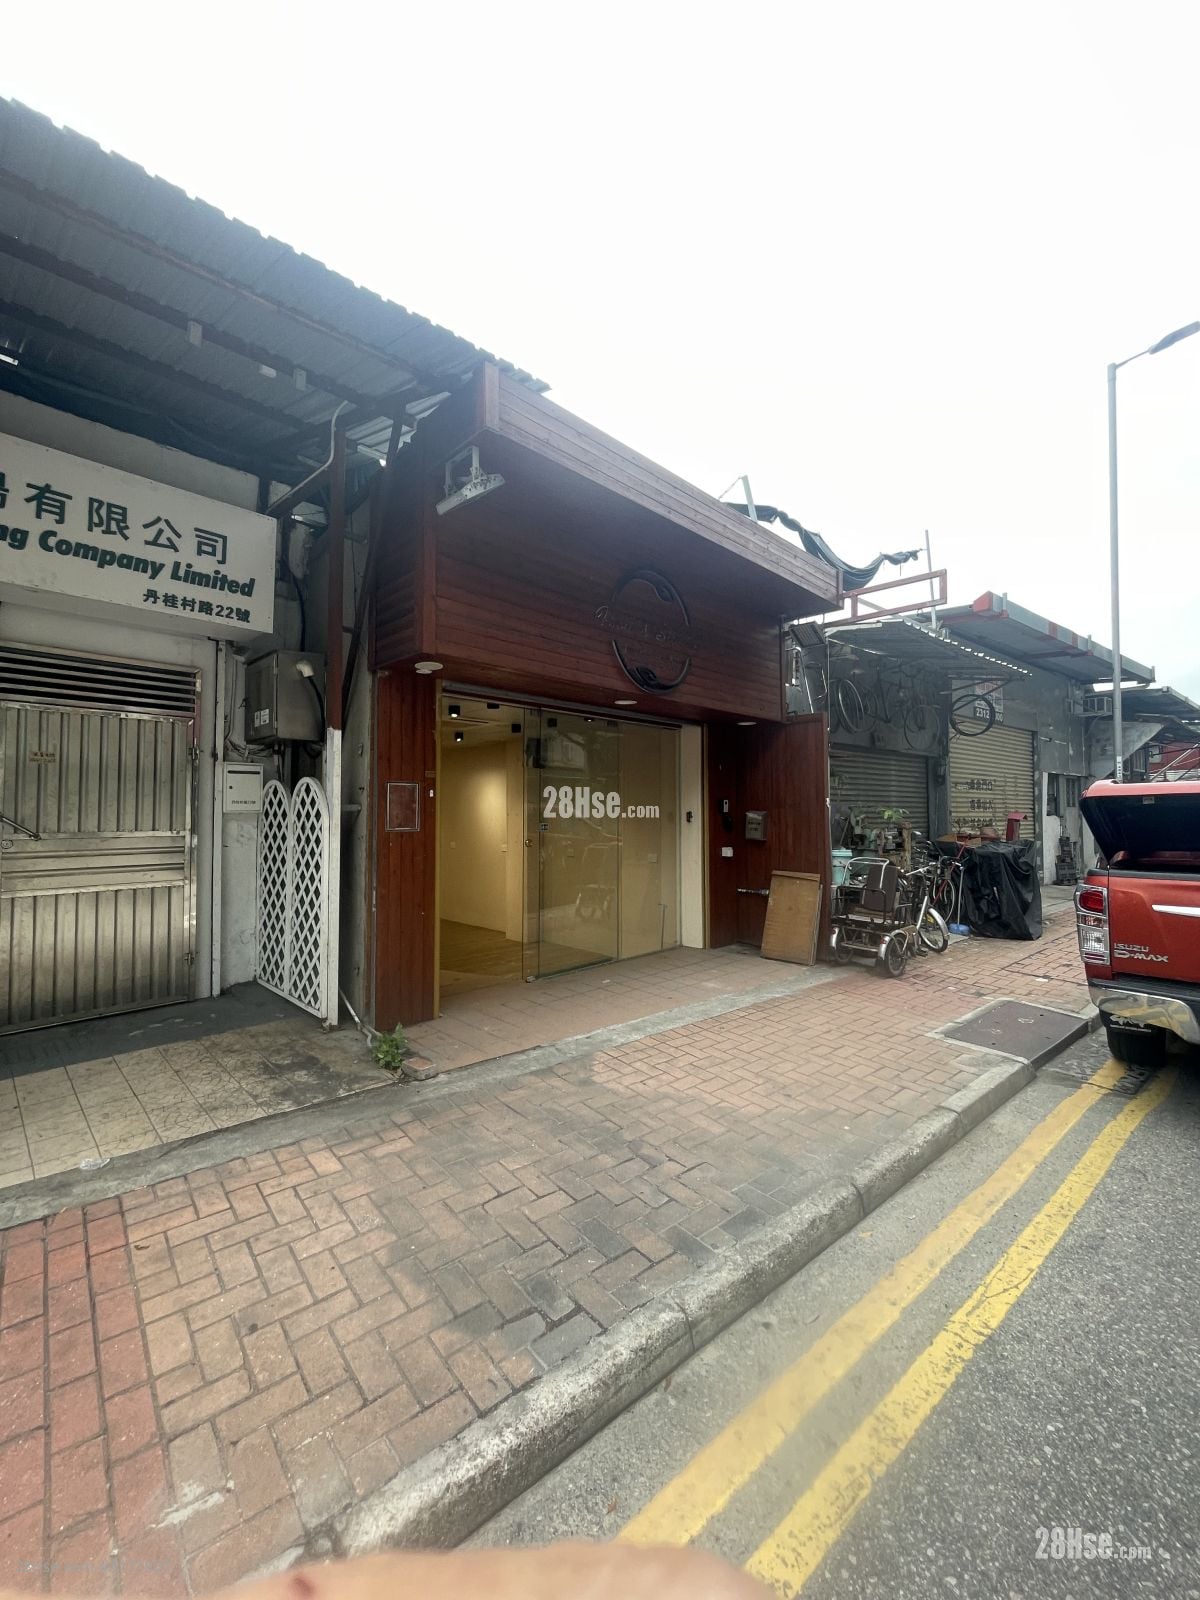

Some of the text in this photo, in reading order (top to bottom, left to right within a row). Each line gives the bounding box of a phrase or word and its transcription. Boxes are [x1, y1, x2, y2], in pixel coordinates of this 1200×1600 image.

[38, 529, 165, 580] Company
[170, 560, 256, 598] Limited
[143, 588, 251, 623] 丹桂村路22號
[1113, 942, 1150, 952] ISUZU
[1113, 950, 1169, 963] D-MAX
